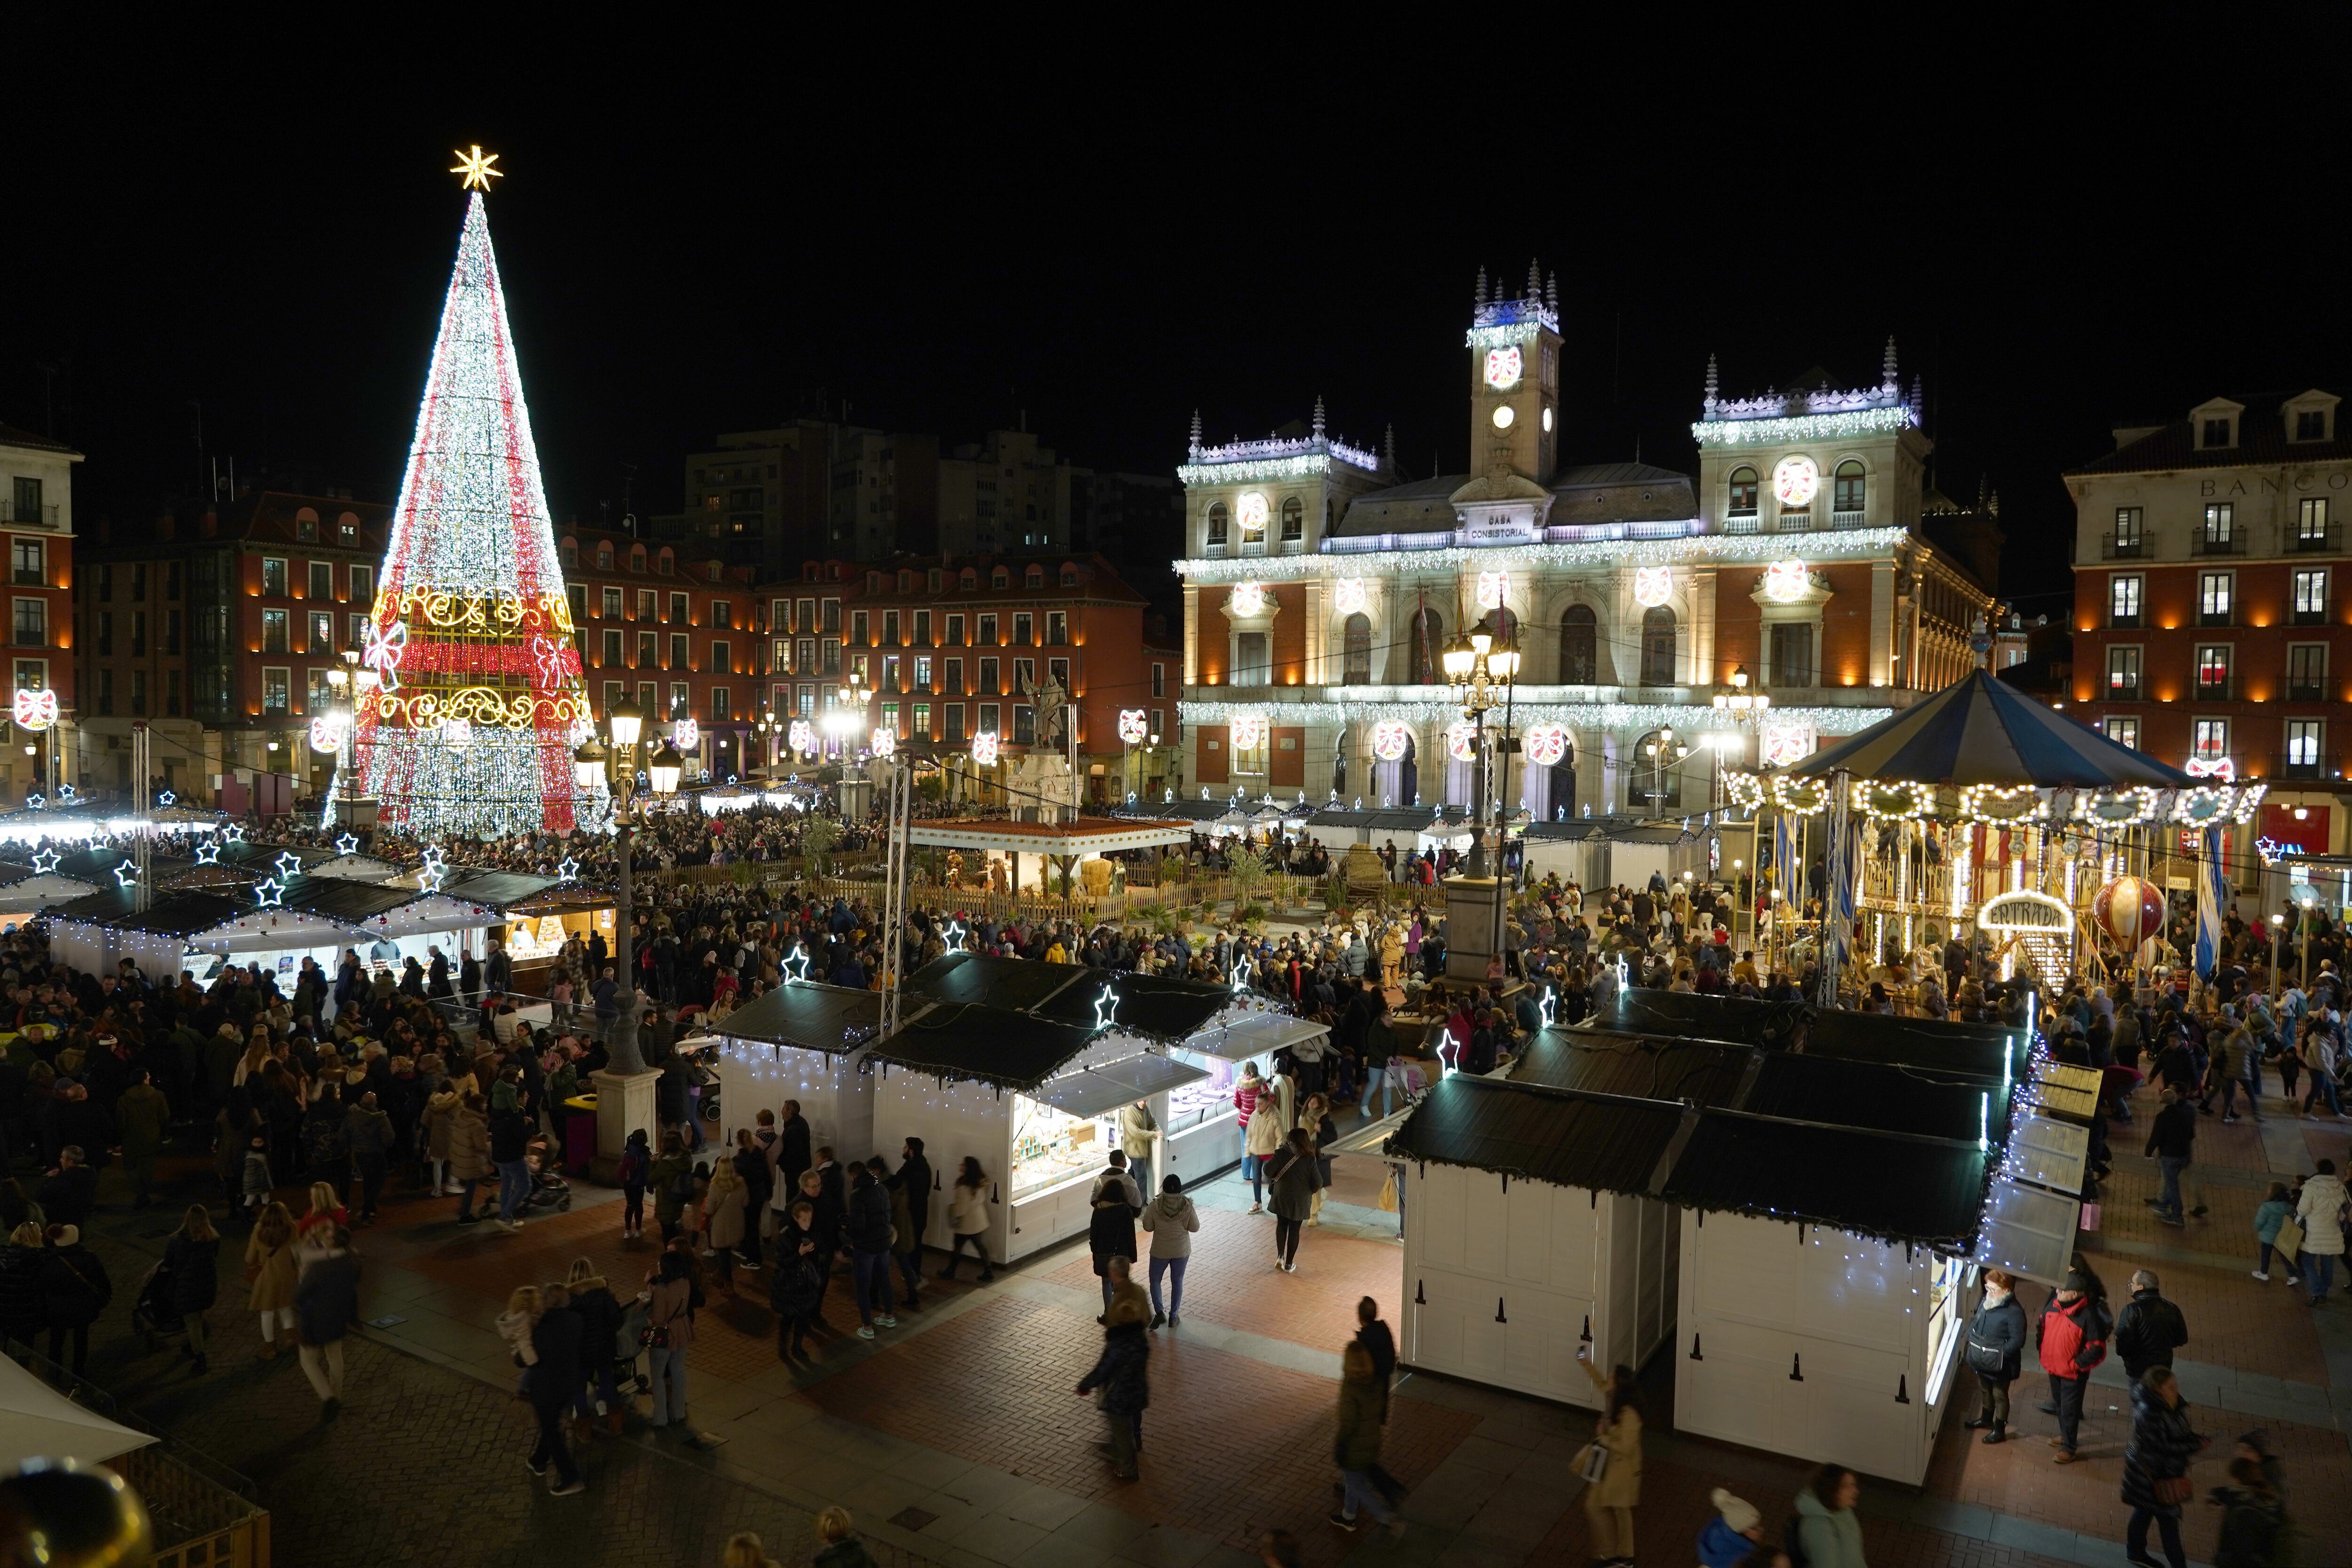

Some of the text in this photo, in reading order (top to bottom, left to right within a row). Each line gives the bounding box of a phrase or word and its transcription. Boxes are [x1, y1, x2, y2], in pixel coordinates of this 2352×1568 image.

[2201, 472, 2349, 497] BANCO
[1488, 514, 1511, 525] CASA
[1471, 528, 1528, 539] CONSISTORIAL
[1983, 794, 2025, 803] Carrusel
[1990, 902, 2062, 927] ENTRADA
